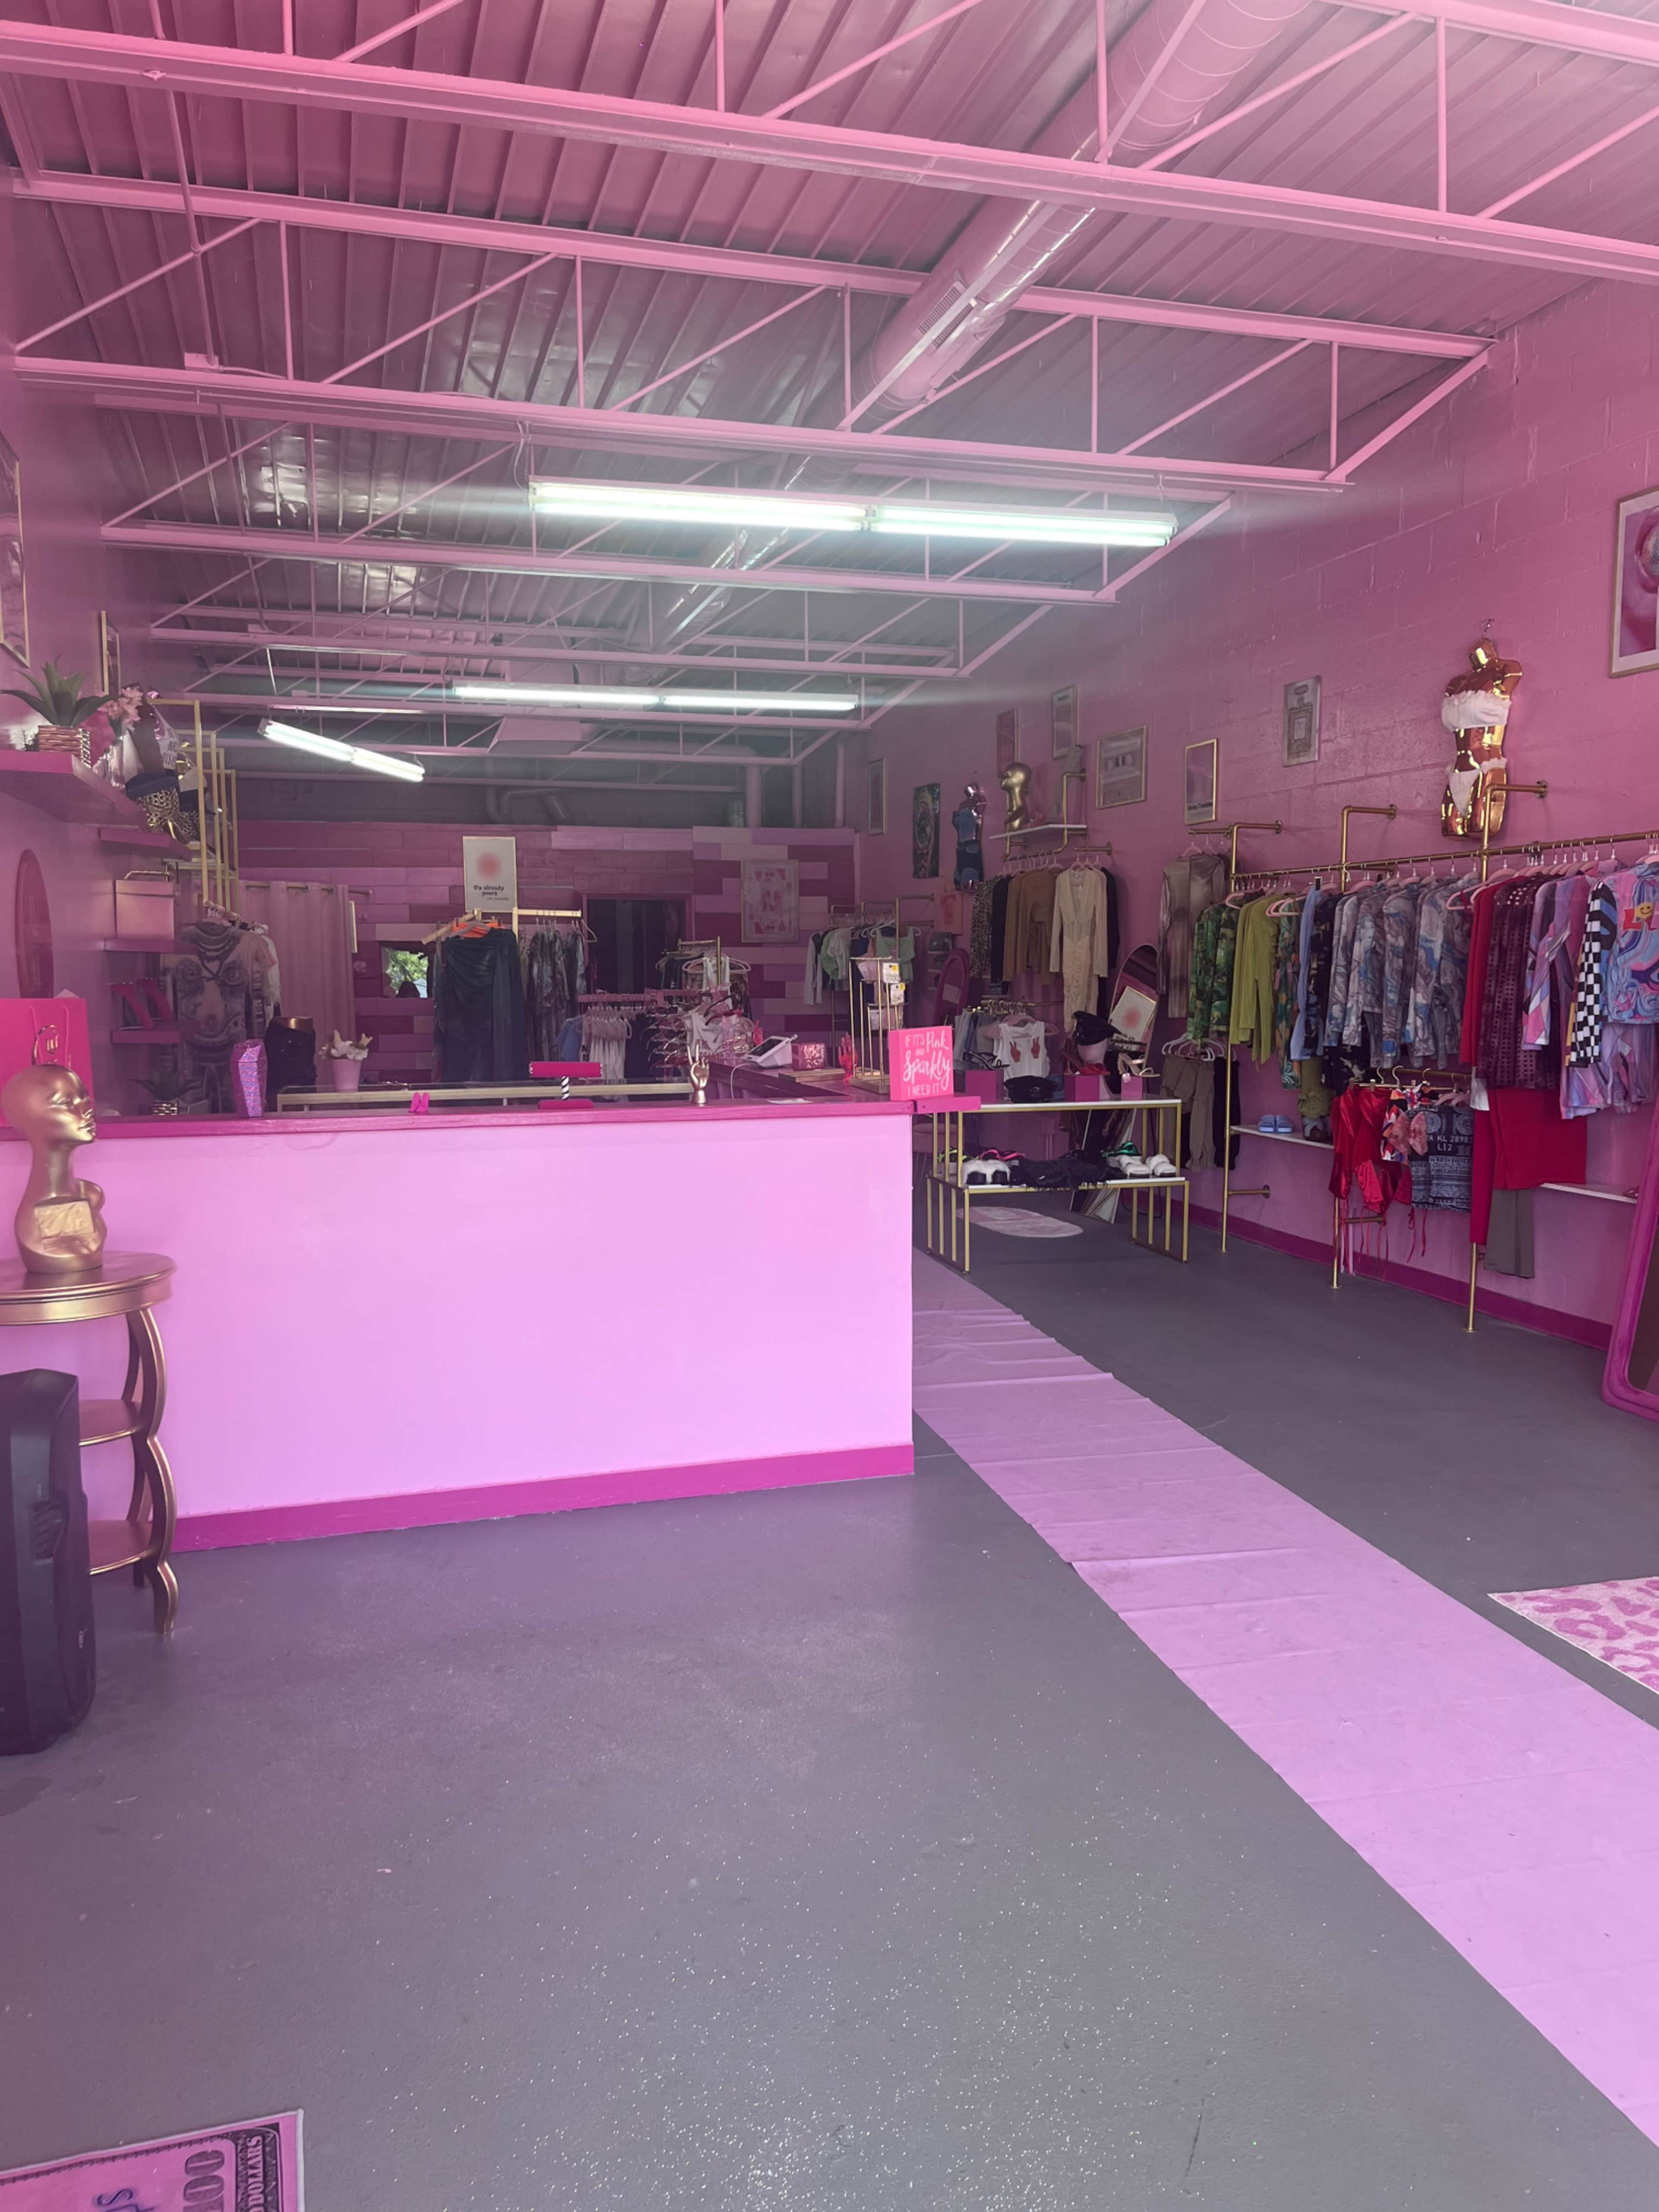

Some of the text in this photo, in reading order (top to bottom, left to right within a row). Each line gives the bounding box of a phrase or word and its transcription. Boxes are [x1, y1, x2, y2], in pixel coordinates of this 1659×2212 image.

[905, 1035, 910, 1047] IF
[926, 1030, 949, 1052] Pink
[903, 1050, 951, 1091] Sparkly
[912, 1084, 930, 1096] NEED
[932, 1083, 940, 1094] IT
[247, 2136, 264, 2206] DOLLARS
